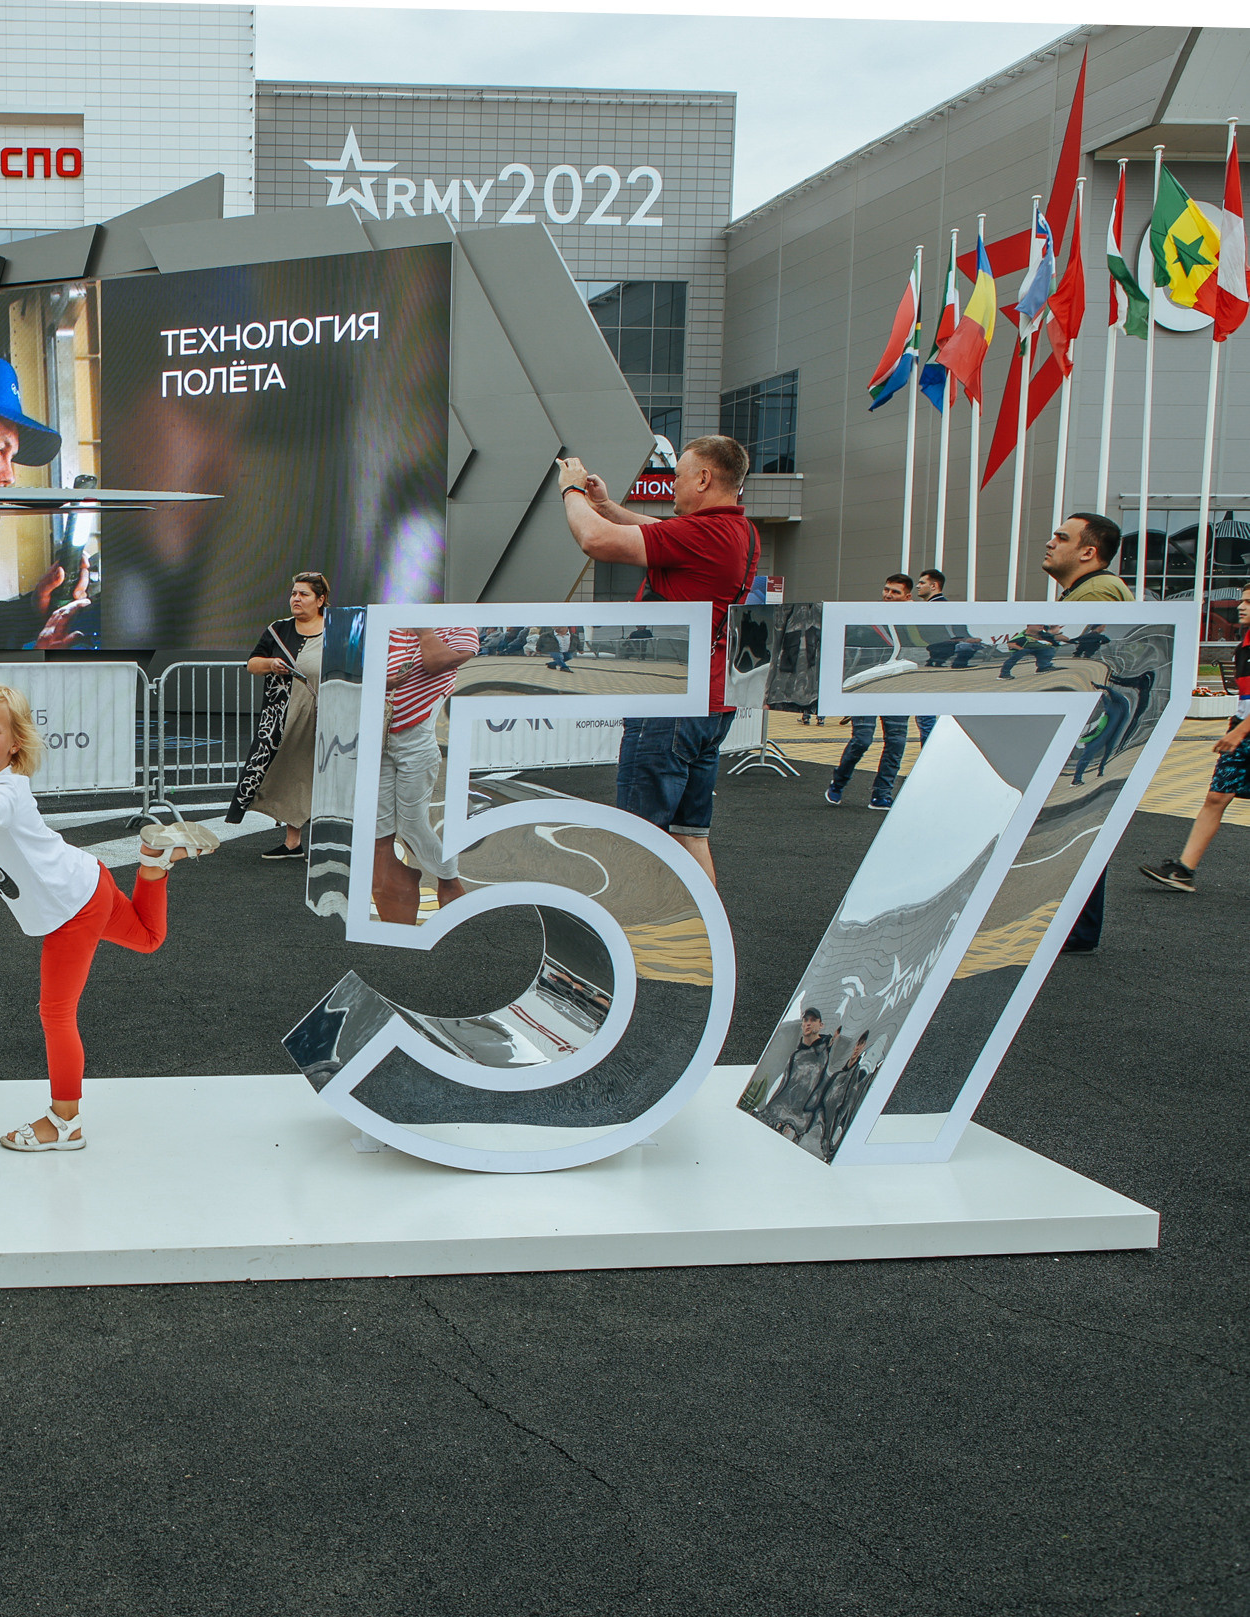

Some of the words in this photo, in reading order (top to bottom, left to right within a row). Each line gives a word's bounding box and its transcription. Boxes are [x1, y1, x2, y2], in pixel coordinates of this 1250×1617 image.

[498, 163, 663, 227] 2022
[160, 311, 380, 357] ТЕХНОЛОГИЯ
[161, 359, 287, 398] ПОЛЁТА
[630, 480, 676, 495] TION
[575, 718, 624, 729] КОРПОРАЦИЯ
